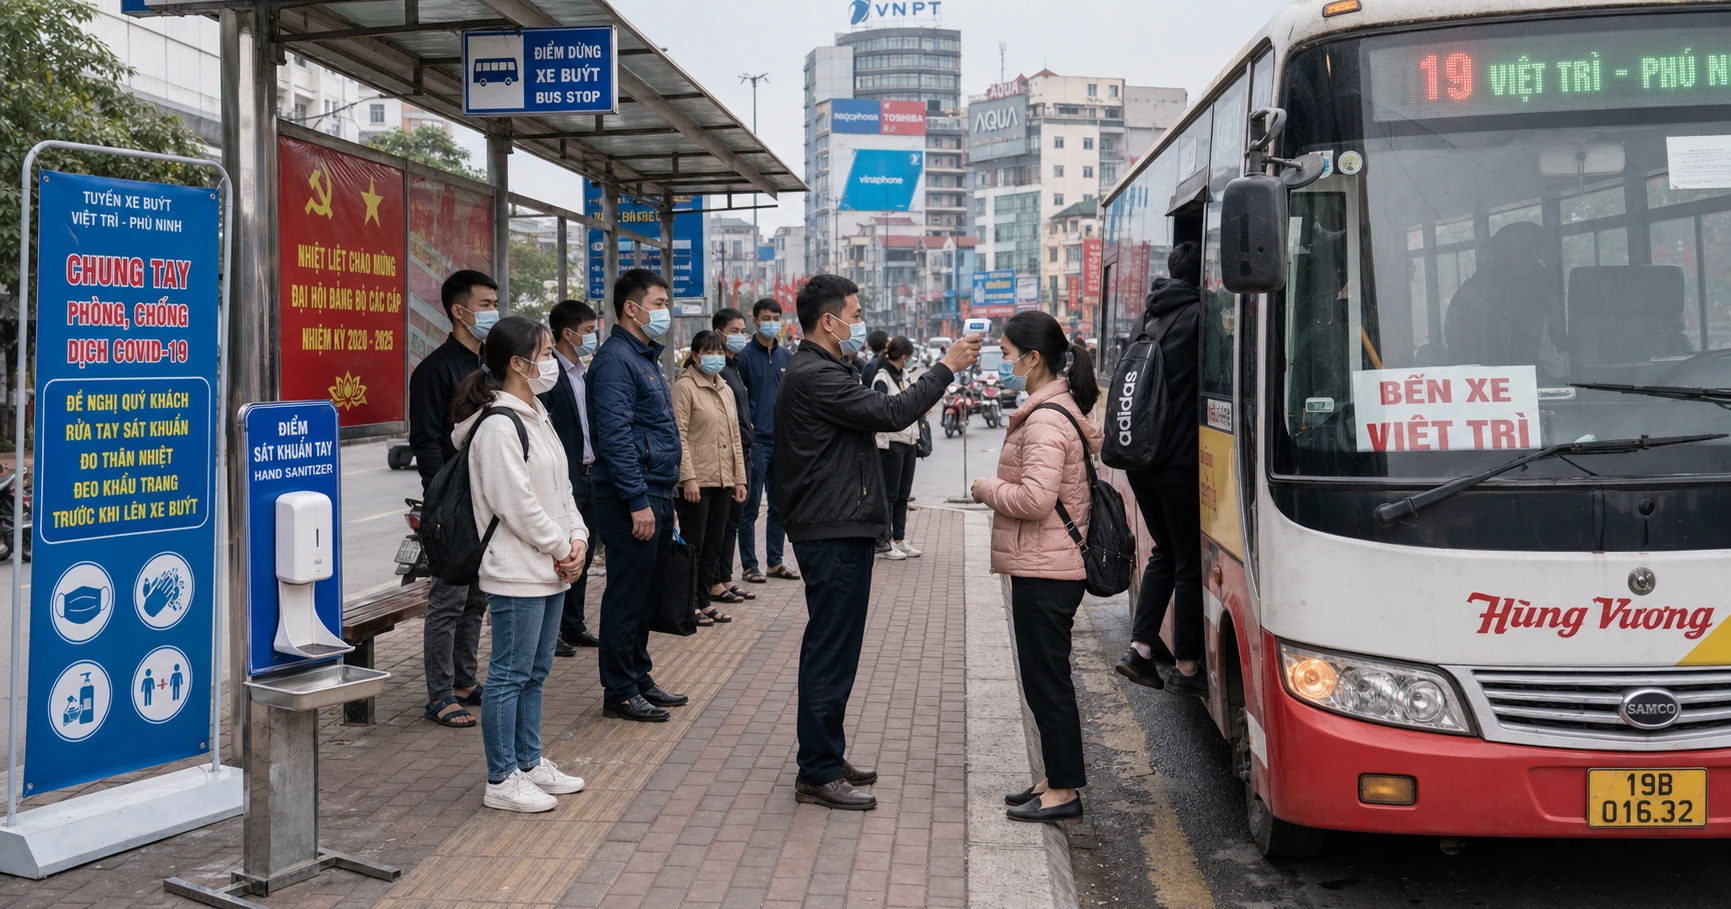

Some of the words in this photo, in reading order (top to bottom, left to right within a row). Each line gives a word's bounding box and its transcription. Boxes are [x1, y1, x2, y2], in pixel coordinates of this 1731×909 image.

[876, 1, 941, 17] VNPT
[534, 40, 564, 60] ĐIỂM
[568, 41, 601, 59] DỪNG
[536, 68, 556, 83] XE
[561, 63, 600, 83] BUÝT
[1419, 52, 1472, 100] 19
[1490, 55, 1546, 102] VIỆT
[1557, 51, 1600, 92] TRÌ
[1642, 48, 1695, 89] PHÚ
[536, 91, 562, 104] BUS
[566, 90, 600, 103] STOP
[883, 113, 923, 122] TOSHIBA
[974, 106, 1018, 132] AQUA
[859, 174, 904, 185] vinaphone
[83, 189, 121, 207] TUYẾN
[125, 195, 140, 209] XE
[143, 196, 172, 212] BUÝT
[71, 209, 97, 228] VIỆT
[100, 212, 118, 228] TRÌ
[155, 218, 182, 233] NINH
[66, 253, 144, 288] CHUNG
[150, 258, 191, 290] TAY
[298, 241, 325, 274] NHIỆT
[328, 244, 347, 276] LIỆT
[349, 247, 370, 274] CHÀO
[291, 284, 308, 313] ĐẠI
[311, 281, 327, 314] HỘI
[369, 286, 385, 312] CÁC
[67, 296, 130, 330] PHÒNG,
[134, 296, 189, 328] CHỐNG
[302, 323, 331, 355] NHIỆM
[334, 323, 346, 350] KỲ
[347, 329, 368, 351] 2020
[374, 329, 394, 351] 2025
[67, 338, 109, 369] DỊCH
[113, 338, 188, 363] COVID-19
[87, 394, 118, 414] NGHỊ
[121, 389, 146, 412] QUÝ
[149, 388, 189, 409] KHÁCH
[1379, 373, 1452, 406] BẾN
[1465, 377, 1512, 403] XE
[1117, 371, 1138, 447] adidas
[65, 418, 92, 441] RỬA
[96, 422, 119, 440] TAY
[123, 418, 146, 438] SÁT
[149, 413, 189, 437] KHUẨN
[277, 414, 308, 436] ĐIỂM
[1466, 412, 1530, 450] TRÌ
[80, 452, 98, 470] ĐO
[102, 447, 135, 469] THÂN
[139, 445, 173, 469] NHIỆT
[254, 442, 274, 462] SÁT
[314, 440, 333, 457] TAY
[73, 481, 99, 499] ĐEO
[103, 472, 136, 496] KHẨU
[140, 474, 178, 493] TRANG
[254, 468, 282, 482] HAND
[285, 463, 333, 478] SANITIZER
[53, 504, 95, 528] TRƯỚC
[99, 505, 120, 523] KHI
[124, 501, 146, 521] LÊN
[150, 502, 165, 518] XE
[169, 495, 198, 516] BUÝT
[1466, 591, 1589, 638] Hùng
[1592, 596, 1715, 640] Vương
[1627, 703, 1676, 715] SAMCO
[1626, 772, 1673, 796] 19B
[1602, 800, 1693, 824] 016.32
